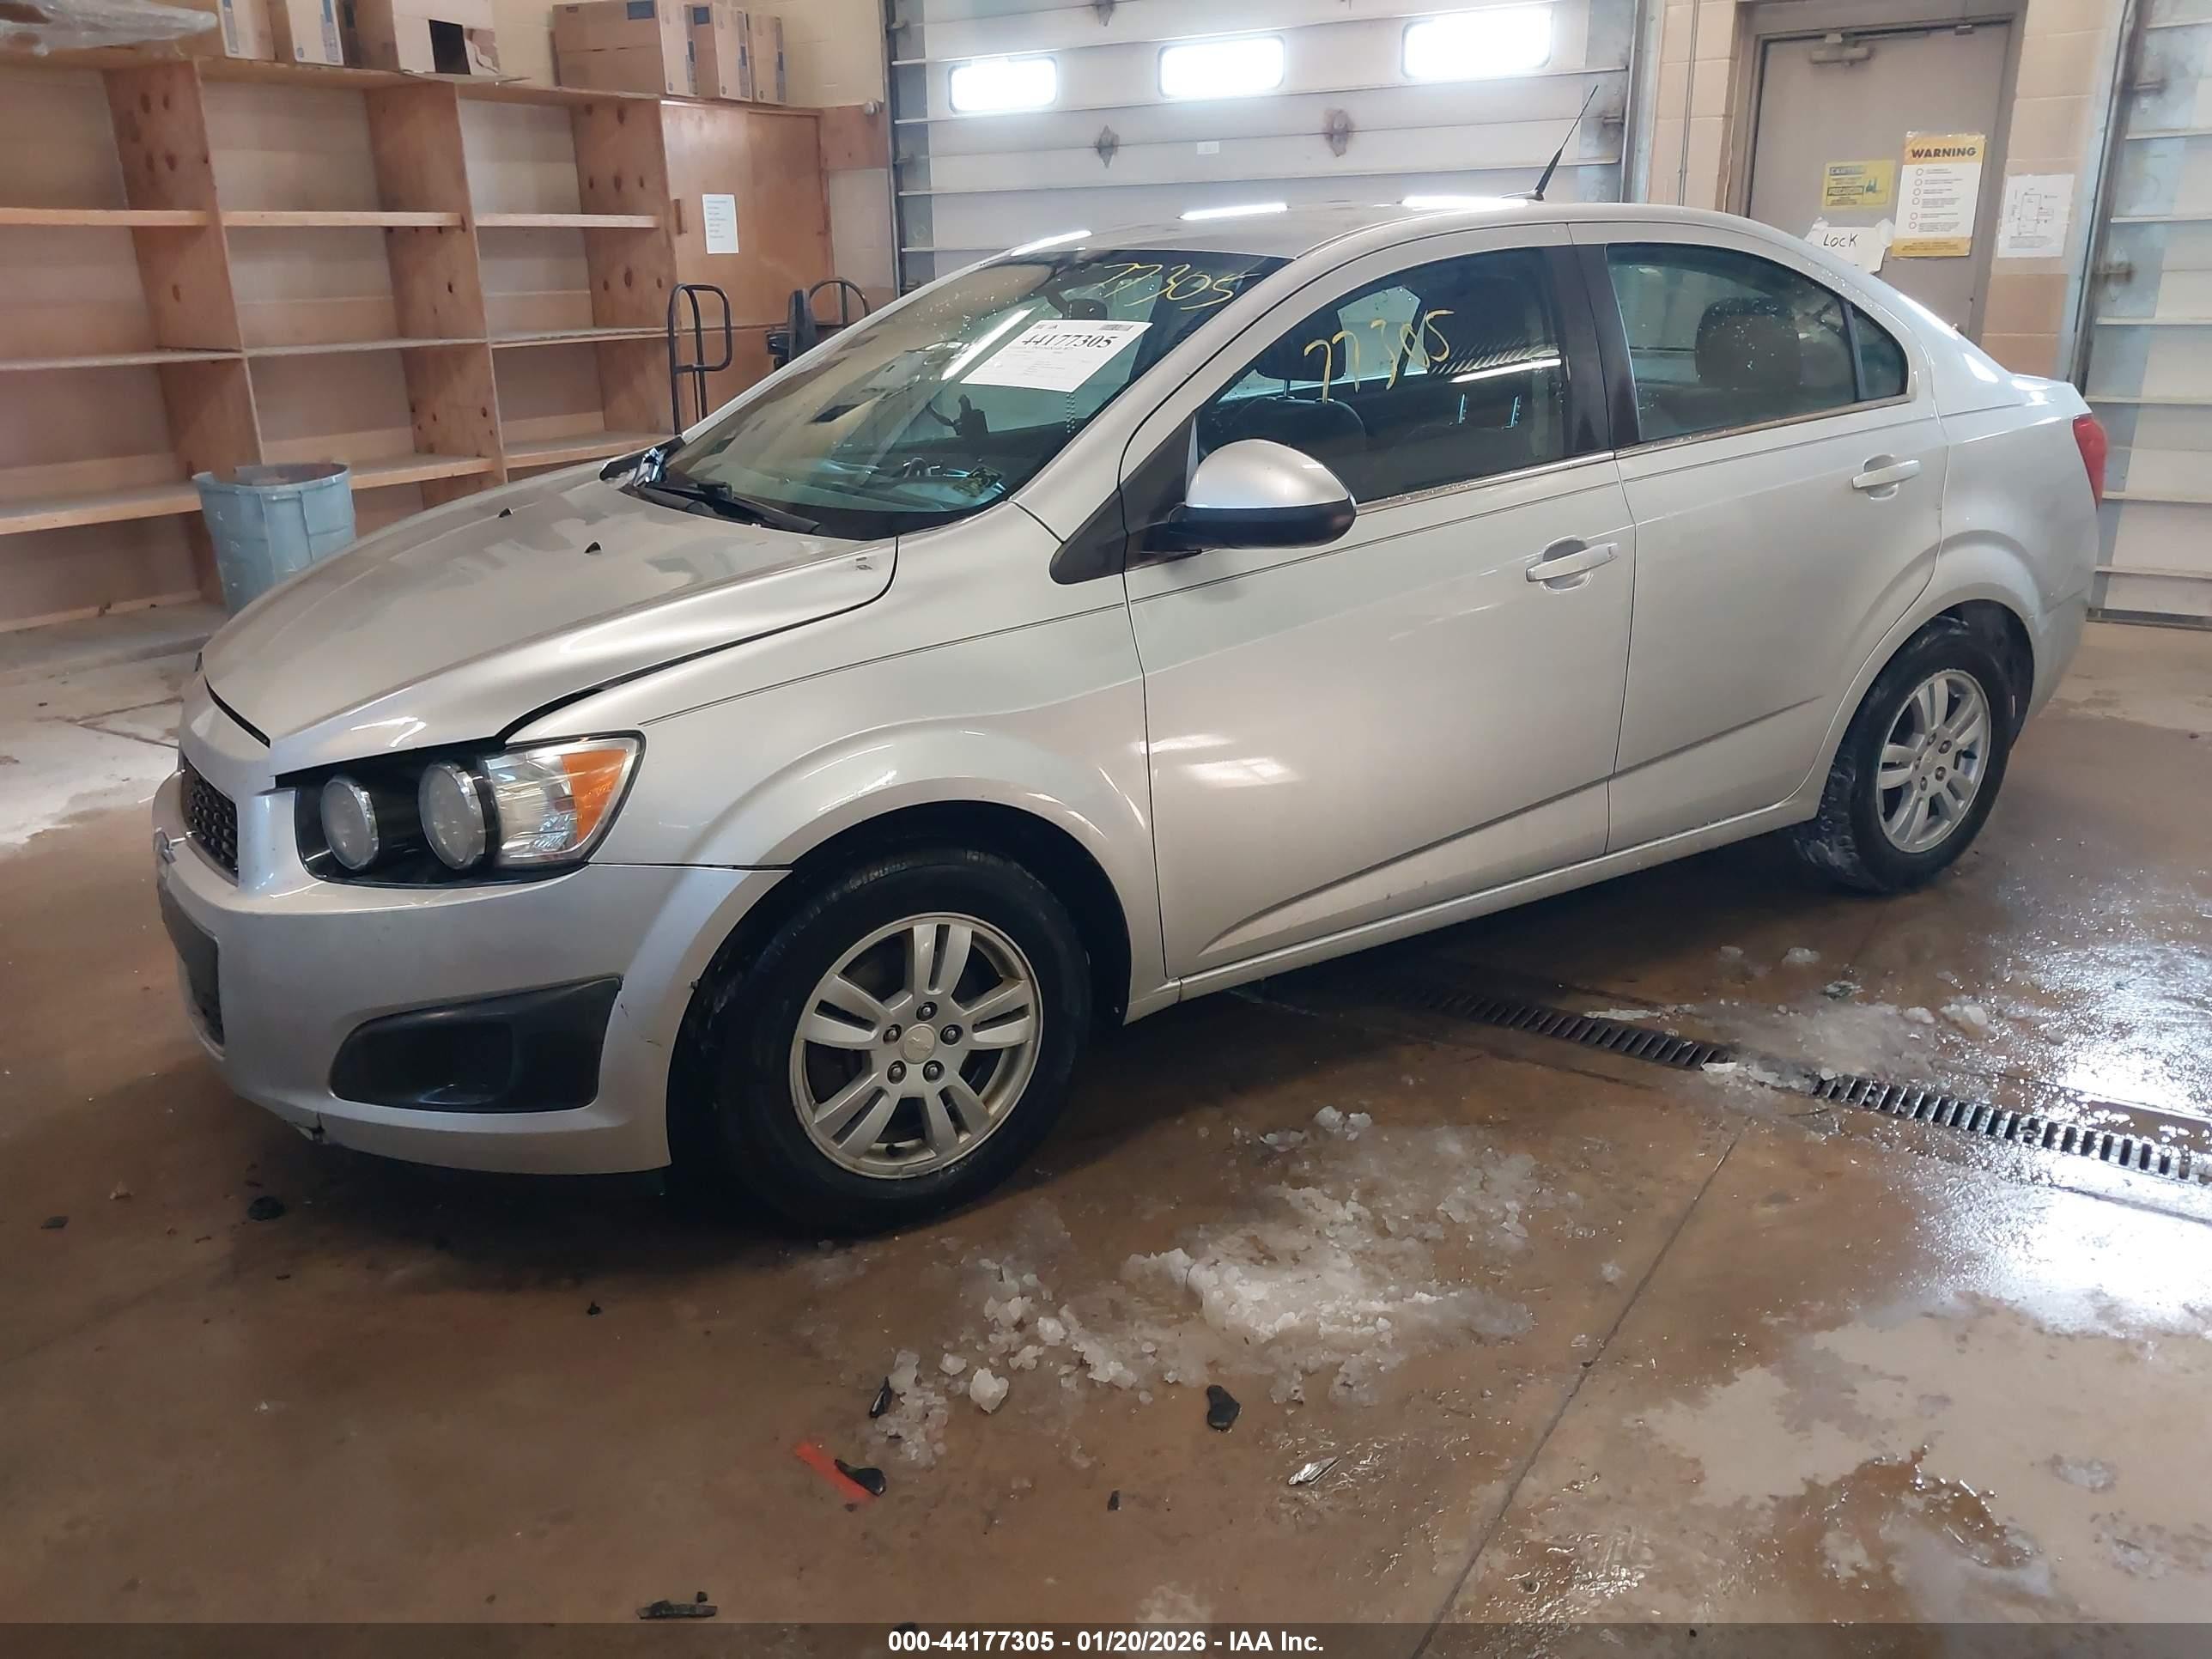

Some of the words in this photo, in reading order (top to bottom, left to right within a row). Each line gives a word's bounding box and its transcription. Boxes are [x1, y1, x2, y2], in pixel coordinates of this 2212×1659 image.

[1911, 147, 1977, 159] WARNING
[1084, 263, 1261, 310] 77305
[1022, 334, 1118, 348] 44177305
[1304, 309, 1455, 404] 77305
